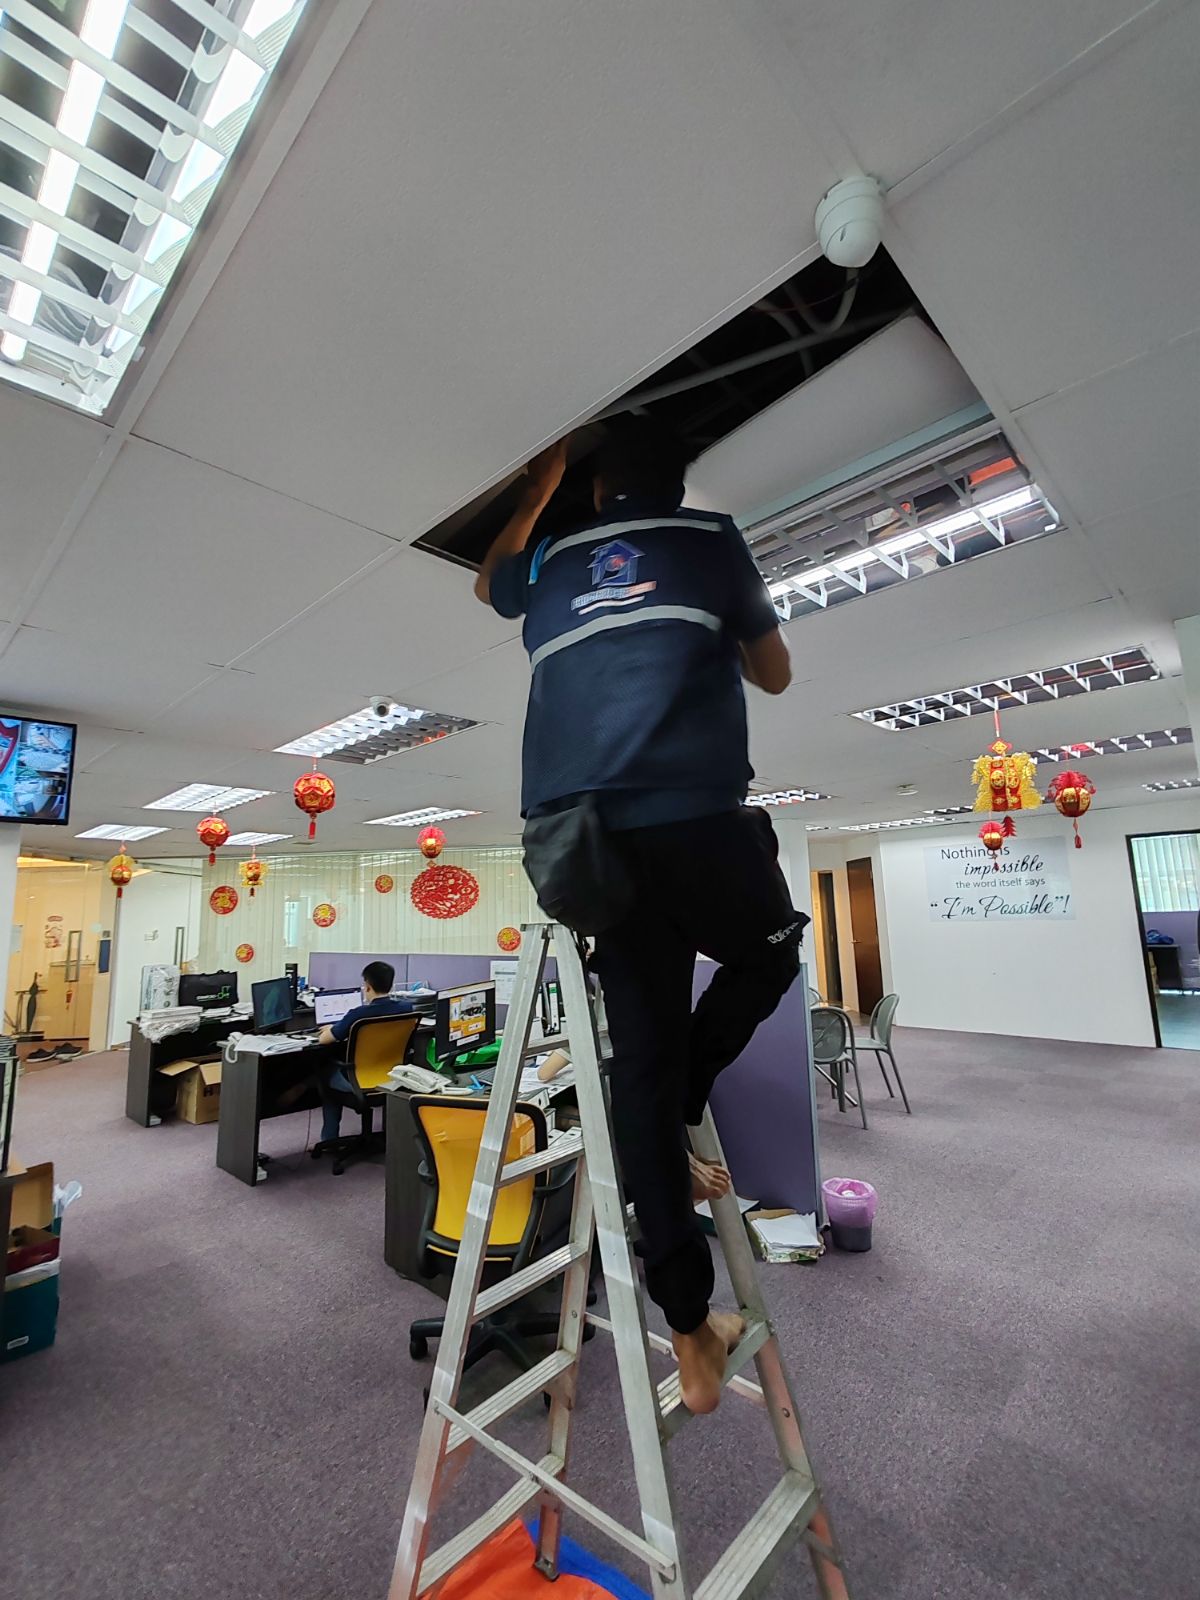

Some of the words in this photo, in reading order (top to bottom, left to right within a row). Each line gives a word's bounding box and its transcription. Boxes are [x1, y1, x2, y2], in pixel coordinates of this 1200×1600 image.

[940, 846, 997, 860] Nothing
[1000, 845, 1010, 856] is
[964, 855, 1043, 880] impossible
[955, 881, 971, 890] the
[973, 879, 997, 889] word
[999, 877, 1022, 887] itself
[1024, 877, 1046, 887] says
